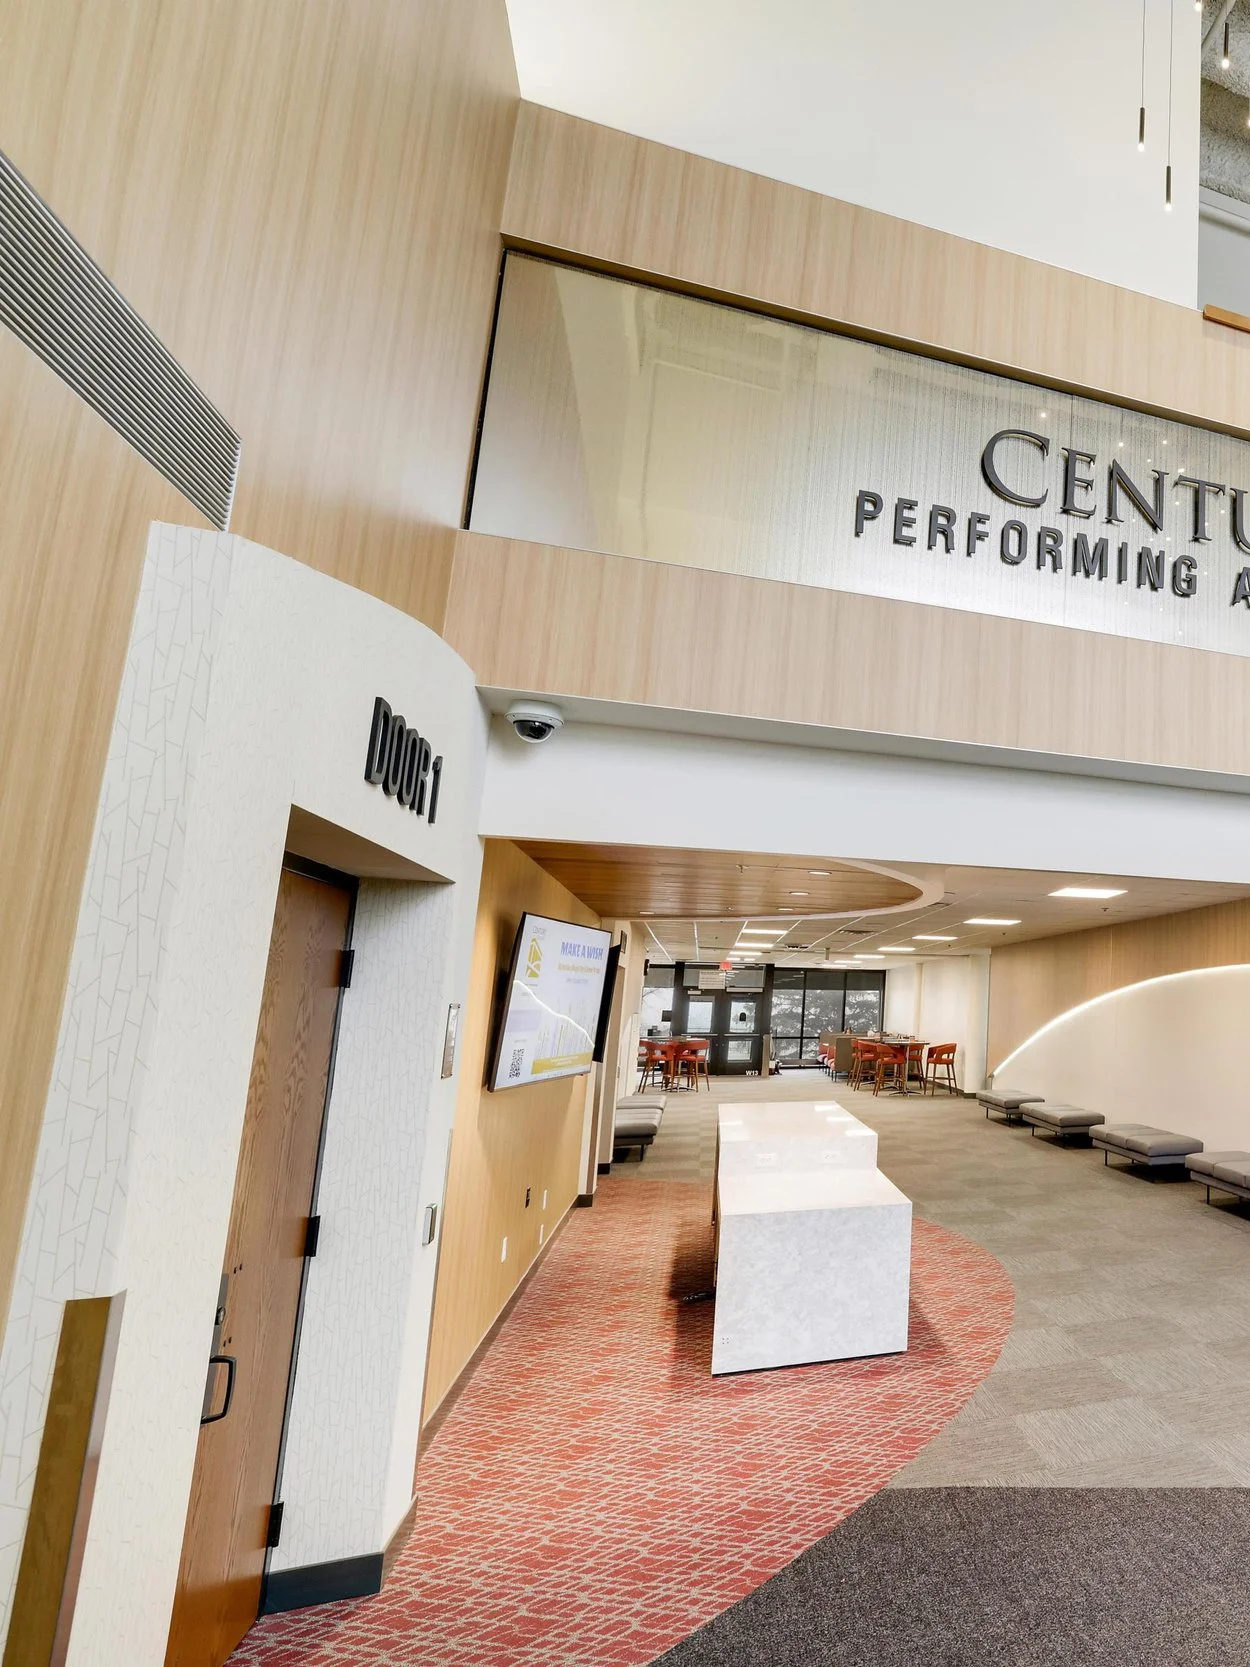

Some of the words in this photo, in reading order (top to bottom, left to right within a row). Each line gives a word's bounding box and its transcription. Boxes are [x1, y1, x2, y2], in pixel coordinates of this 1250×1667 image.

[855, 489, 1198, 597] PERFORMING
[364, 696, 432, 816] DOOR
[428, 755, 443, 824] 1
[561, 942, 581, 957] MAKE
[587, 945, 604, 960] WISH
